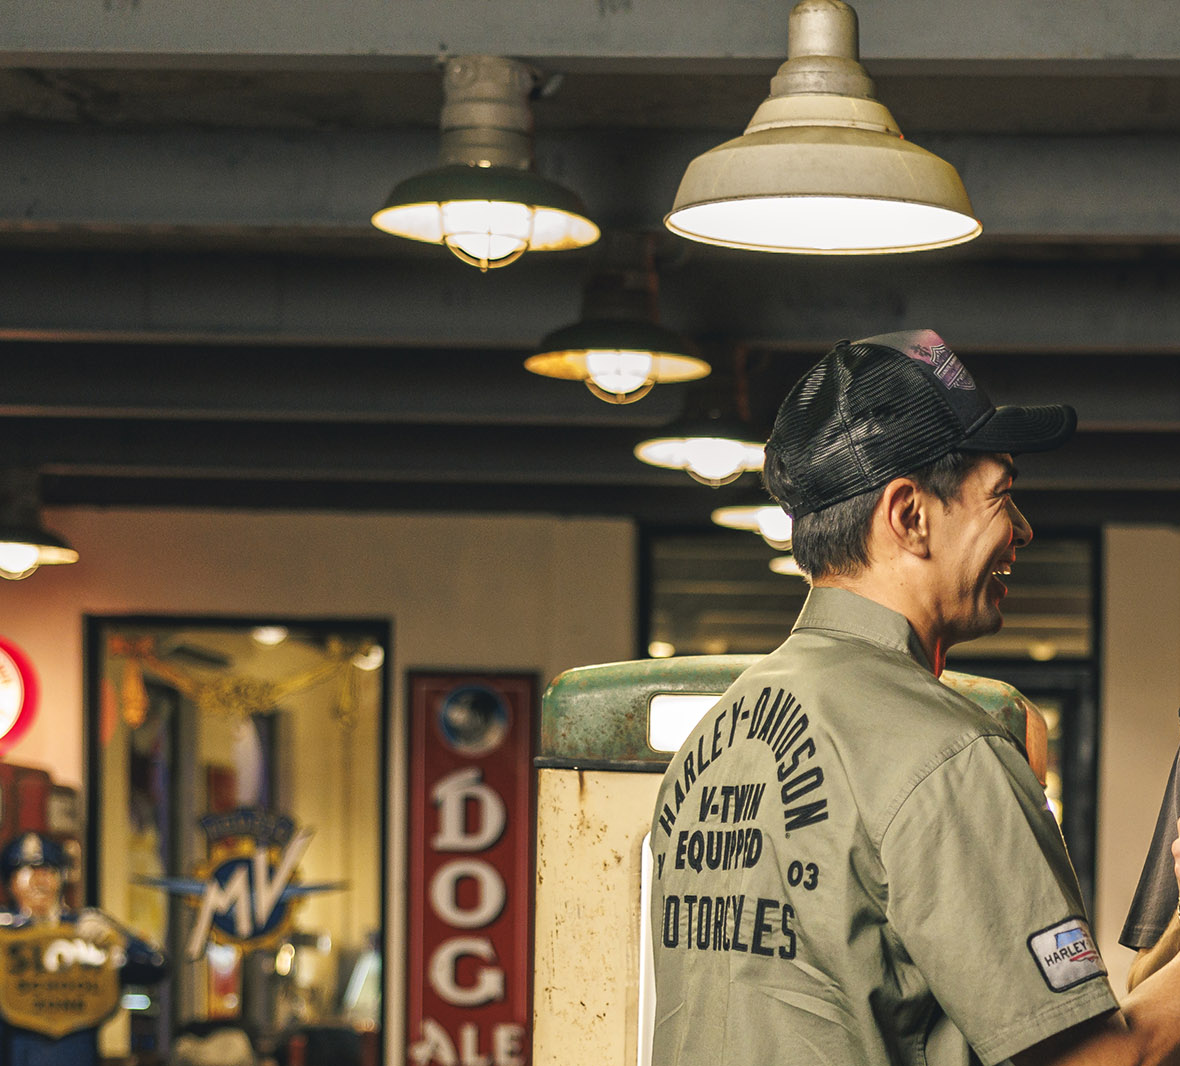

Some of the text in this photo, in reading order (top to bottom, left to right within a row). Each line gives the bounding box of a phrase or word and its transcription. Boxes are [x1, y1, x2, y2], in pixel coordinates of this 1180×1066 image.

[658, 686, 829, 838] HARLEY-DAVIDSON
[698, 783, 767, 824] V-TWIN
[187, 823, 315, 958] MV
[429, 767, 508, 1008] DOG
[787, 860, 820, 891] 03
[1044, 940, 1088, 967] HARLEY
